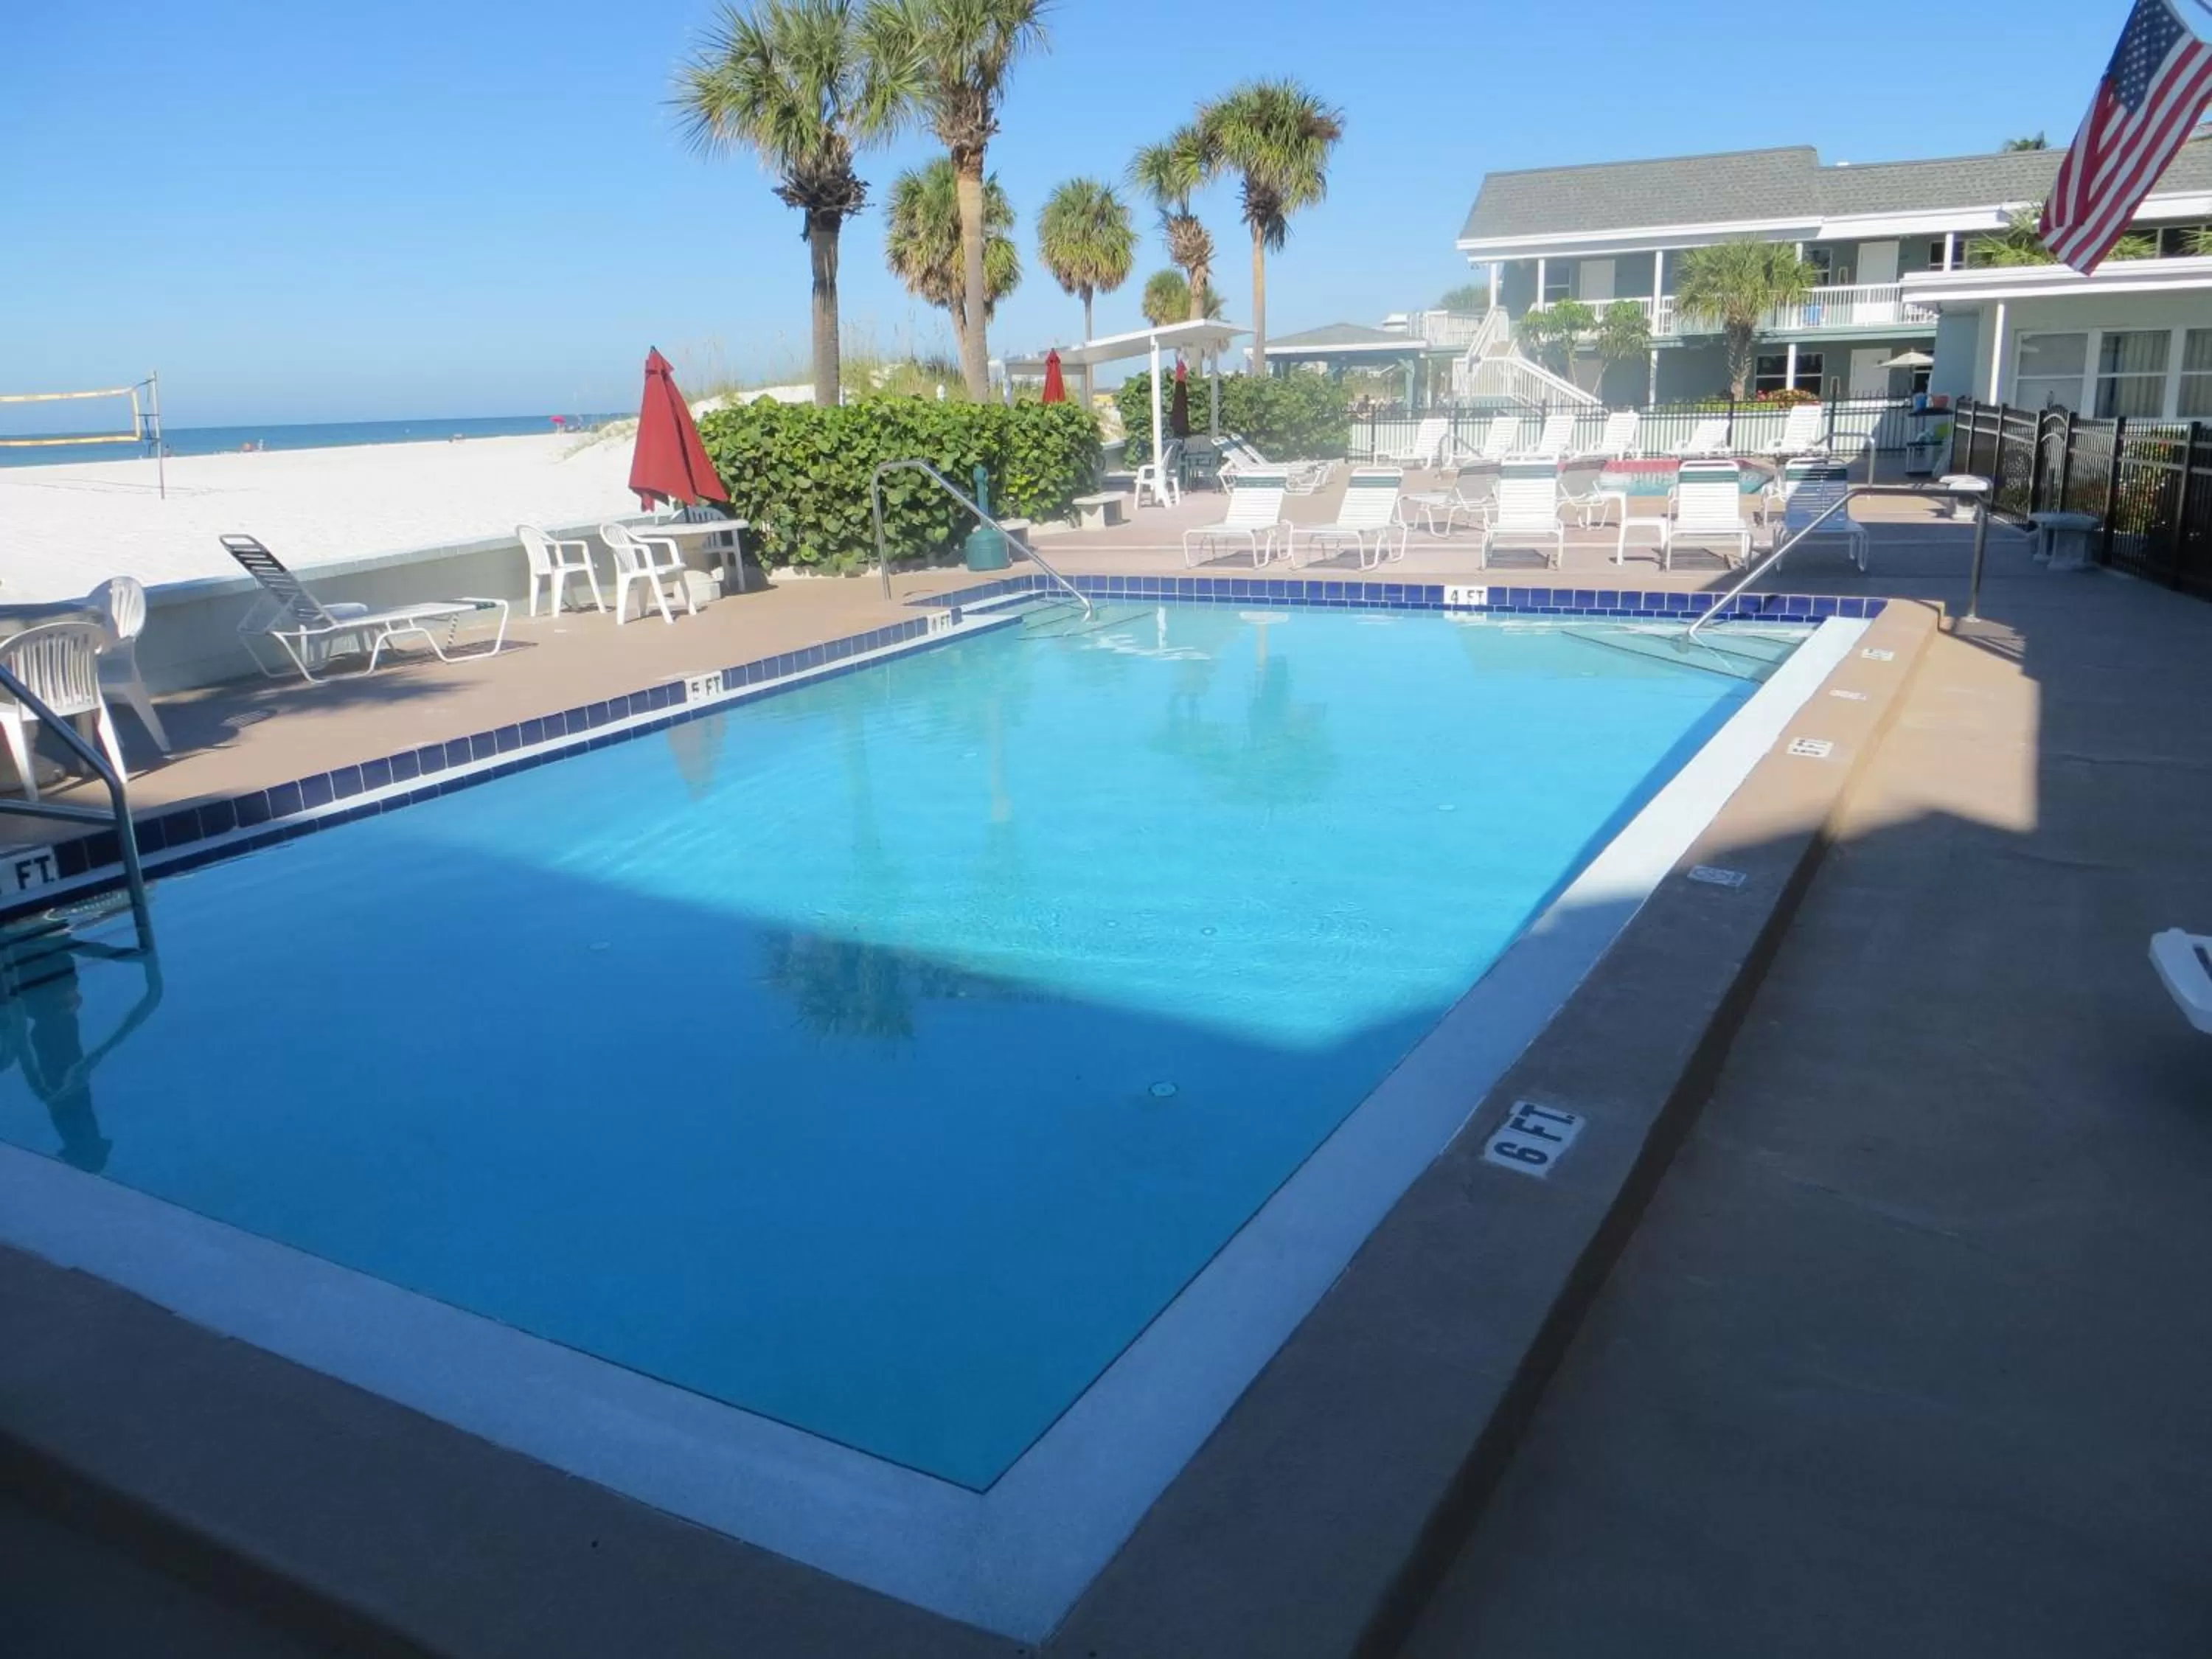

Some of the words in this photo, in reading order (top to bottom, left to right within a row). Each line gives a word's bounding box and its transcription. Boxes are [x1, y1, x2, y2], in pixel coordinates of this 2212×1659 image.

[1451, 589, 1458, 605] 4
[1467, 589, 1485, 605] FT
[691, 681, 700, 700] 5
[706, 675, 720, 696] FT
[1494, 1142, 1548, 1165] 6
